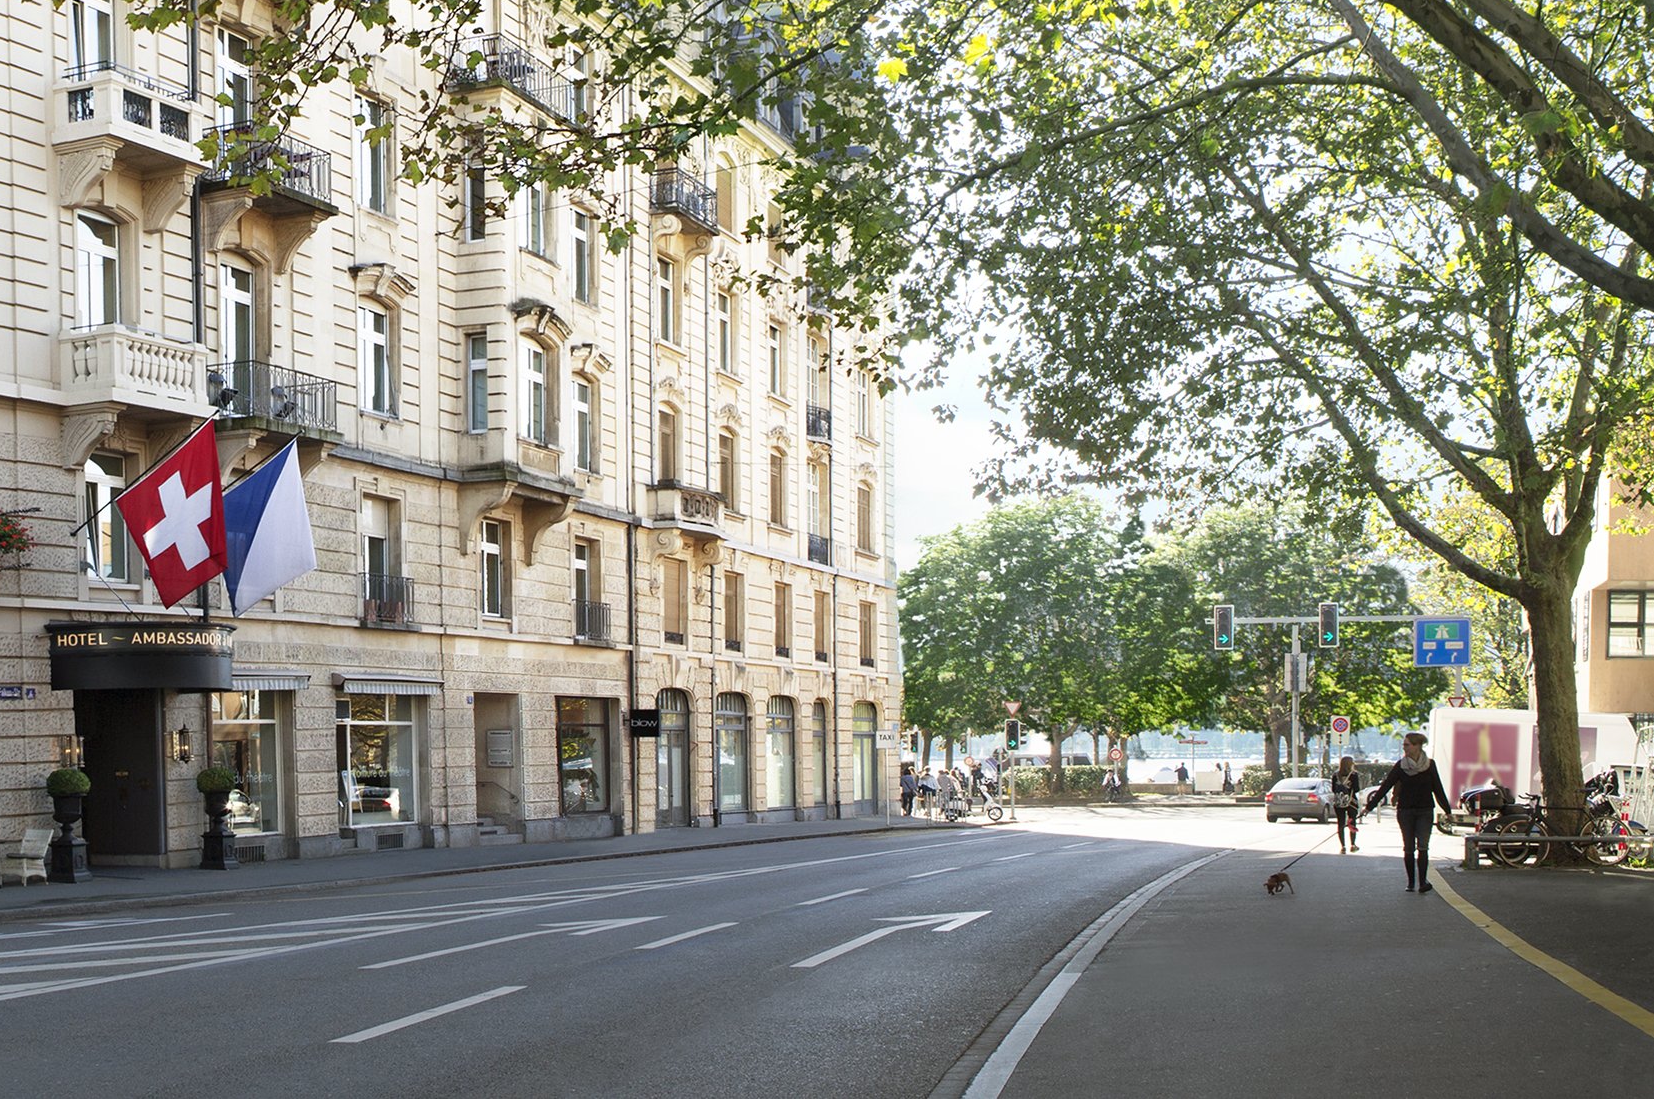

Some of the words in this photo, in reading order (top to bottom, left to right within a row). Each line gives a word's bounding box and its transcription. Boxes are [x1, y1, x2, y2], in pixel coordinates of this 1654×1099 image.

[57, 632, 108, 647] HOTEL
[131, 632, 222, 646] AMBASSADOR
[631, 719, 657, 727] blow
